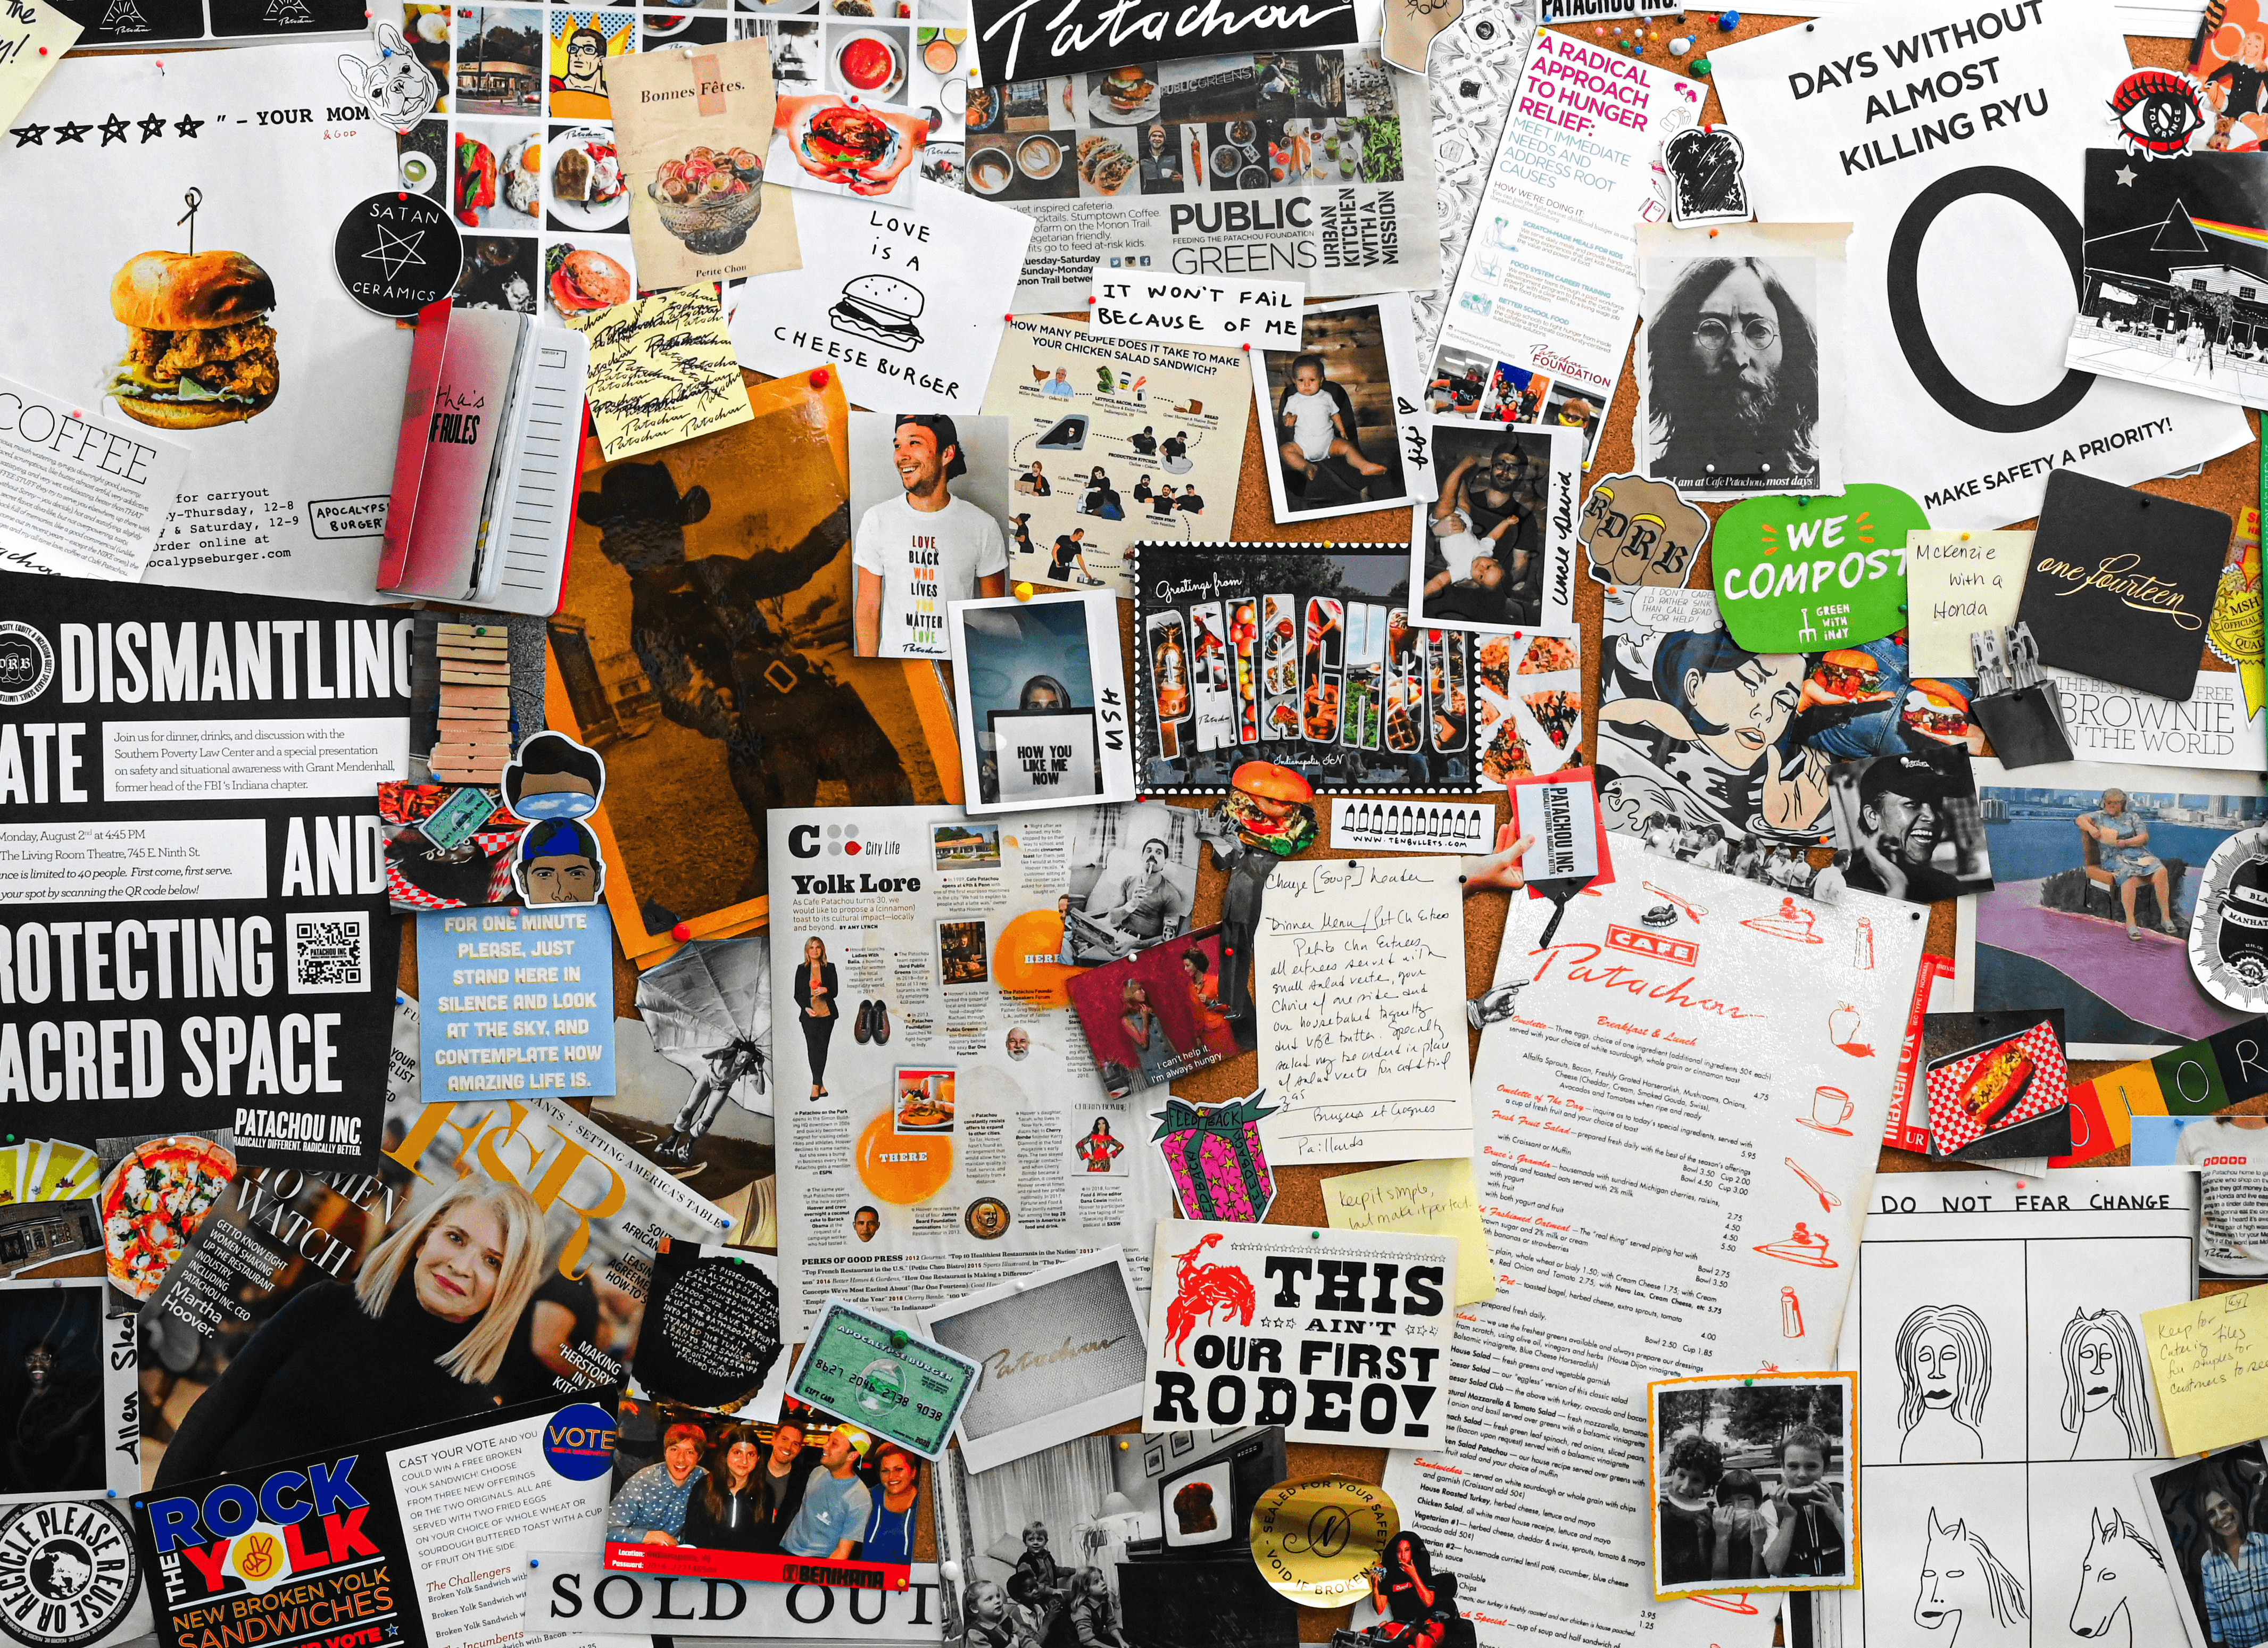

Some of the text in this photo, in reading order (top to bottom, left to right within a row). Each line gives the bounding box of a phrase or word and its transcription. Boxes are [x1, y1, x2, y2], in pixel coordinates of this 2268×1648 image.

[1537, 36, 1650, 87] A RADICAL
[1788, 1, 2043, 100] DAYS WITHOUT
[641, 81, 745, 104] Bonnes Fêtes.
[1531, 56, 1649, 109] APPROACH
[1865, 57, 2000, 124] ALMOST
[256, 109, 313, 125] YOUR
[1518, 97, 1595, 136] RELIEF:
[1528, 76, 1648, 132] TO HUNGER
[323, 130, 331, 139] &
[1839, 89, 2048, 175] KILLING RYU
[2150, 108, 2181, 138] TOLERANCE
[370, 203, 439, 224] SATAN
[870, 210, 931, 243] LOVE
[1170, 197, 1311, 235] PUBLIC
[1173, 236, 1204, 244] FEEDING
[1223, 233, 1264, 242] PATACHOU
[1266, 230, 1315, 240] FOUNDATION
[1320, 206, 1340, 268] URBAN
[1339, 188, 1360, 267] KITCHEN
[1361, 202, 1380, 267] WITH A
[1378, 189, 1399, 266] MISSION
[906, 256, 920, 272] A
[1172, 240, 1317, 274] GREENS
[696, 268, 721, 277] Petite
[353, 282, 436, 302] CERAMICS
[1103, 284, 1131, 299] IT
[1148, 286, 1223, 303] WON'T
[1098, 308, 1297, 336] BECAUSE OF ME
[774, 326, 960, 400] CHEESE BURGER
[1032, 336, 1217, 377] YOUR CHICKEN SALAD SANDWICH?
[1924, 417, 2174, 510] MAKE SAFETY A PRIORITY!
[1695, 478, 1705, 487] at
[1706, 477, 1725, 488] Cafe
[1725, 477, 1765, 487] Patachou,
[1766, 477, 1789, 486] most
[1791, 476, 1813, 487] days
[176, 488, 269, 504] for carryout
[317, 503, 389, 518] APOCALYPS
[330, 518, 382, 532] BURGER
[1786, 514, 1849, 552] WE
[912, 536, 936, 550] LOVE
[1916, 544, 1997, 561] McKenzie
[909, 551, 939, 567] BLACK
[914, 567, 934, 581] WHO
[1156, 572, 1242, 603] Greetings from
[1724, 548, 1907, 601] COMPOST
[1993, 575, 2003, 589] a
[911, 583, 938, 598] LIVES
[2037, 554, 2202, 630] one fourteen
[916, 600, 934, 612] YOU
[1933, 602, 1988, 619] Honda
[906, 614, 943, 629] MATTER
[913, 630, 936, 644] LOVE
[60, 618, 414, 703] DISMANTLING
[1146, 594, 1469, 762] PATACHOU
[2057, 677, 2233, 701] THE FREE
[2059, 693, 2233, 734] BROWNIE
[114, 731, 135, 742] Join
[151, 731, 164, 742] for
[166, 731, 199, 742] dinner,
[201, 730, 232, 742] drinks,
[235, 731, 253, 740] and
[255, 730, 304, 740] discussion
[306, 729, 327, 739] with
[329, 729, 345, 739] the
[2085, 727, 2233, 755] THE WORLD
[1017, 744, 1072, 760] HOW YOU
[1023, 758, 1068, 773] LIKE ME
[1274, 754, 1320, 772] Indianapolis,
[1032, 771, 1059, 786] NOW
[1353, 836, 1467, 848] WWW.TENBULLETS.COM
[1550, 788, 1574, 875] PATACHOU INC.
[280, 814, 387, 897] AND
[866, 841, 900, 856] City Life
[791, 873, 920, 895] Yolk Lore
[444, 913, 587, 933] FOR ONE MINUTE
[458, 940, 575, 959] PLEASE, JUST
[1613, 931, 1690, 959] CAFE
[452, 966, 580, 986] STAND HERE IN
[437, 992, 597, 1013] SILENCE AND LOOK
[446, 1019, 589, 1039] AT THE SKY, AND
[1597, 1016, 1699, 1046] Breakfast & Lunch
[180, 1012, 342, 1097] SPACE
[435, 1045, 602, 1066] CONTEMPLATE HOW
[1162, 1055, 1182, 1068] can't
[1182, 1049, 1201, 1060] help
[1166, 1063, 1193, 1078] always
[1194, 1052, 1224, 1067] hungry.
[447, 1071, 591, 1092] AMAZING LIFE IS.
[1754, 1093, 1769, 1101] 4.75
[235, 1108, 362, 1145] PATACHOU INC.
[879, 1152, 927, 1163] THERE
[1881, 1194, 2170, 1214] DO NOT FEAR CHANGE
[1265, 1255, 1444, 1317] THIS
[161, 1294, 215, 1339] Hoover.
[169, 1283, 223, 1325] Martha
[1305, 1318, 1397, 1336] AIN'T
[1194, 1335, 1440, 1383] OUR FIRST
[1153, 1370, 1439, 1438] RODEO!
[549, 1425, 616, 1451] VOTE
[147, 1454, 370, 1553] ROCK
[36, 1506, 121, 1557] PLEASE
[181, 1506, 380, 1594] YOLK
[165, 1552, 187, 1602] THE
[70, 1559, 125, 1629] REUSE
[173, 1567, 391, 1632] NEW BROKEN YOLK
[550, 1574, 938, 1626] SOLD OUT
[37, 1602, 66, 1633] OR
